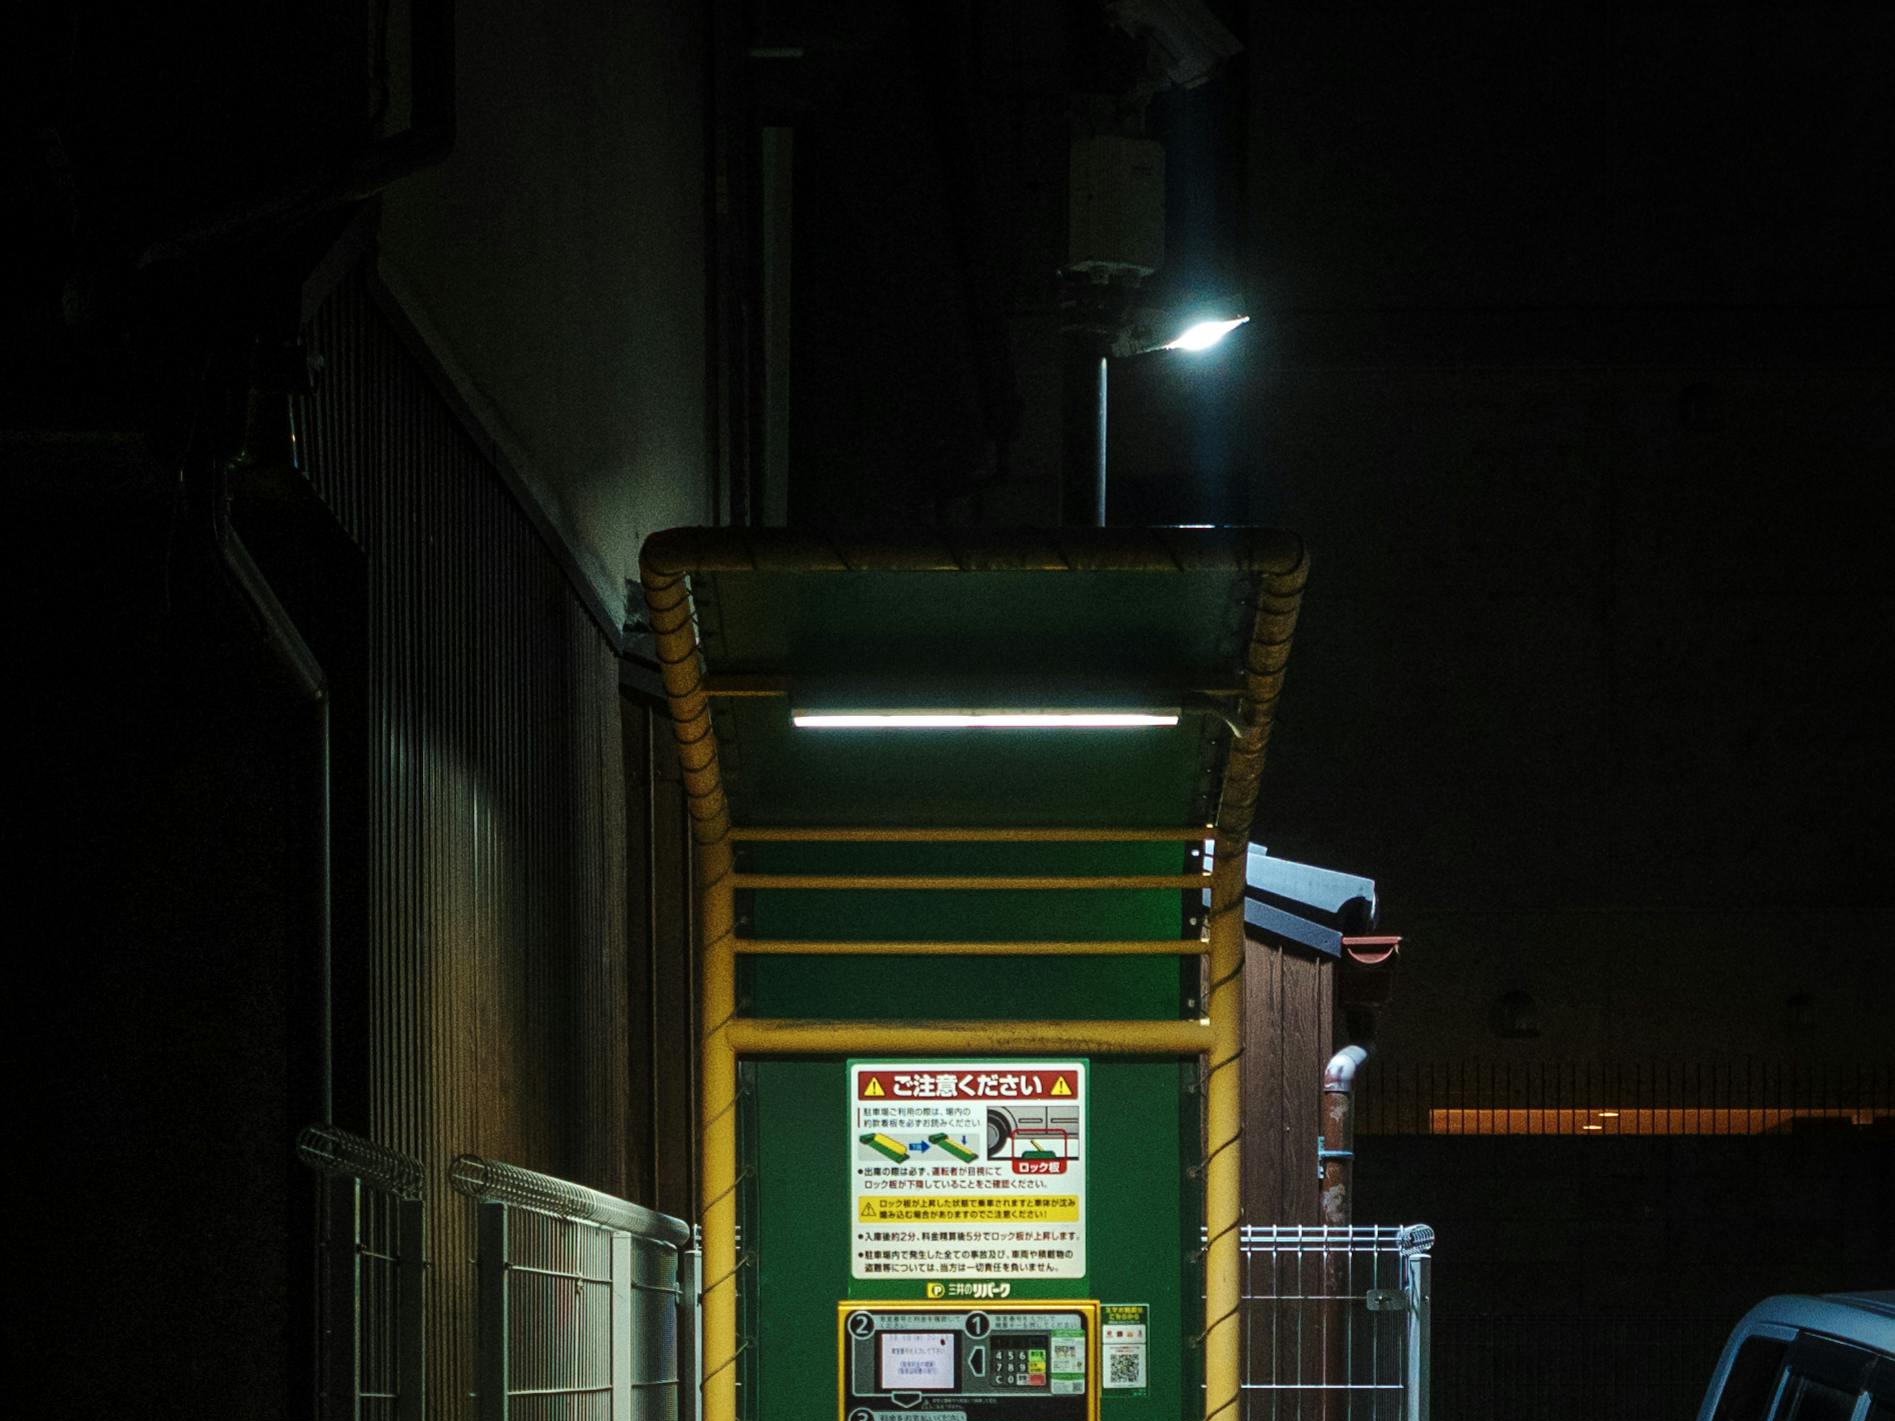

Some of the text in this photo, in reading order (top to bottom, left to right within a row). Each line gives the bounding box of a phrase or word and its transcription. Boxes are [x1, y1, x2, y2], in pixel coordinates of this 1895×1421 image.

[893, 1074, 1042, 1097] ご注意ください
[864, 1167, 1002, 1177] 出庫の際は必ず、運転者が目視にて
[1019, 1162, 1060, 1173] ロック板
[864, 1180, 1048, 1190] ロック板が下降していることをご確認ください。
[864, 1250, 1074, 1260] 駐車場内で発生した全ての事故及び、車両や積載物の
[864, 1263, 1059, 1272] 盗難等については、当方は一切責任を負いません。
[948, 1282, 1010, 1298] 三井のリパーク
[855, 1315, 869, 1334] 2
[972, 1316, 981, 1335] 1
[995, 1351, 1002, 1360] 4
[1008, 1351, 1014, 1360] 5
[1019, 1351, 1026, 1360] 6
[996, 1363, 1002, 1372] 7
[1008, 1363, 1014, 1372] 8
[1019, 1363, 1026, 1372] 9
[995, 1375, 1002, 1384] C
[1008, 1375, 1014, 1384] 0
